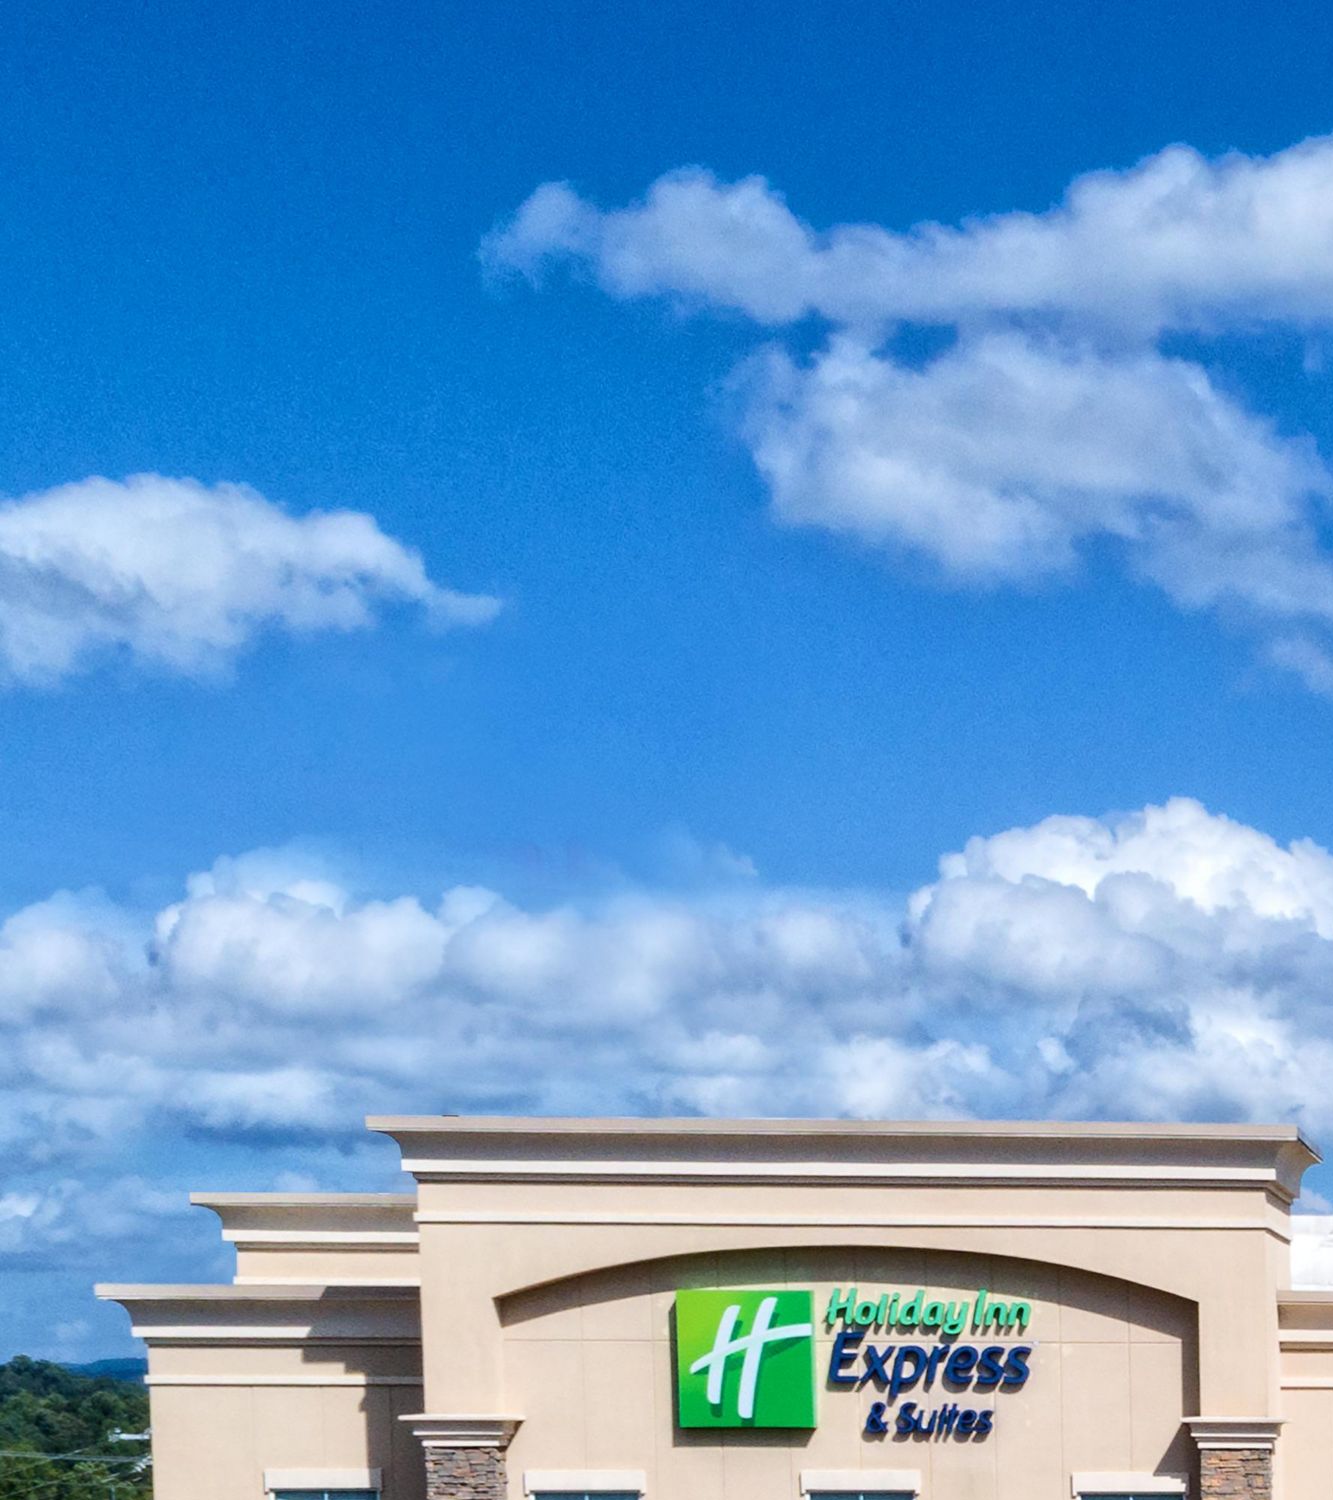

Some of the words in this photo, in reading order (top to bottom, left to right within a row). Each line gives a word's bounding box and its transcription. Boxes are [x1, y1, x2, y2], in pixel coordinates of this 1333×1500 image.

[827, 1287, 970, 1335] Holiday
[973, 1287, 1032, 1327] Inn
[829, 1331, 1032, 1399] Express
[866, 1402, 889, 1434] &
[897, 1402, 994, 1434] Suites
